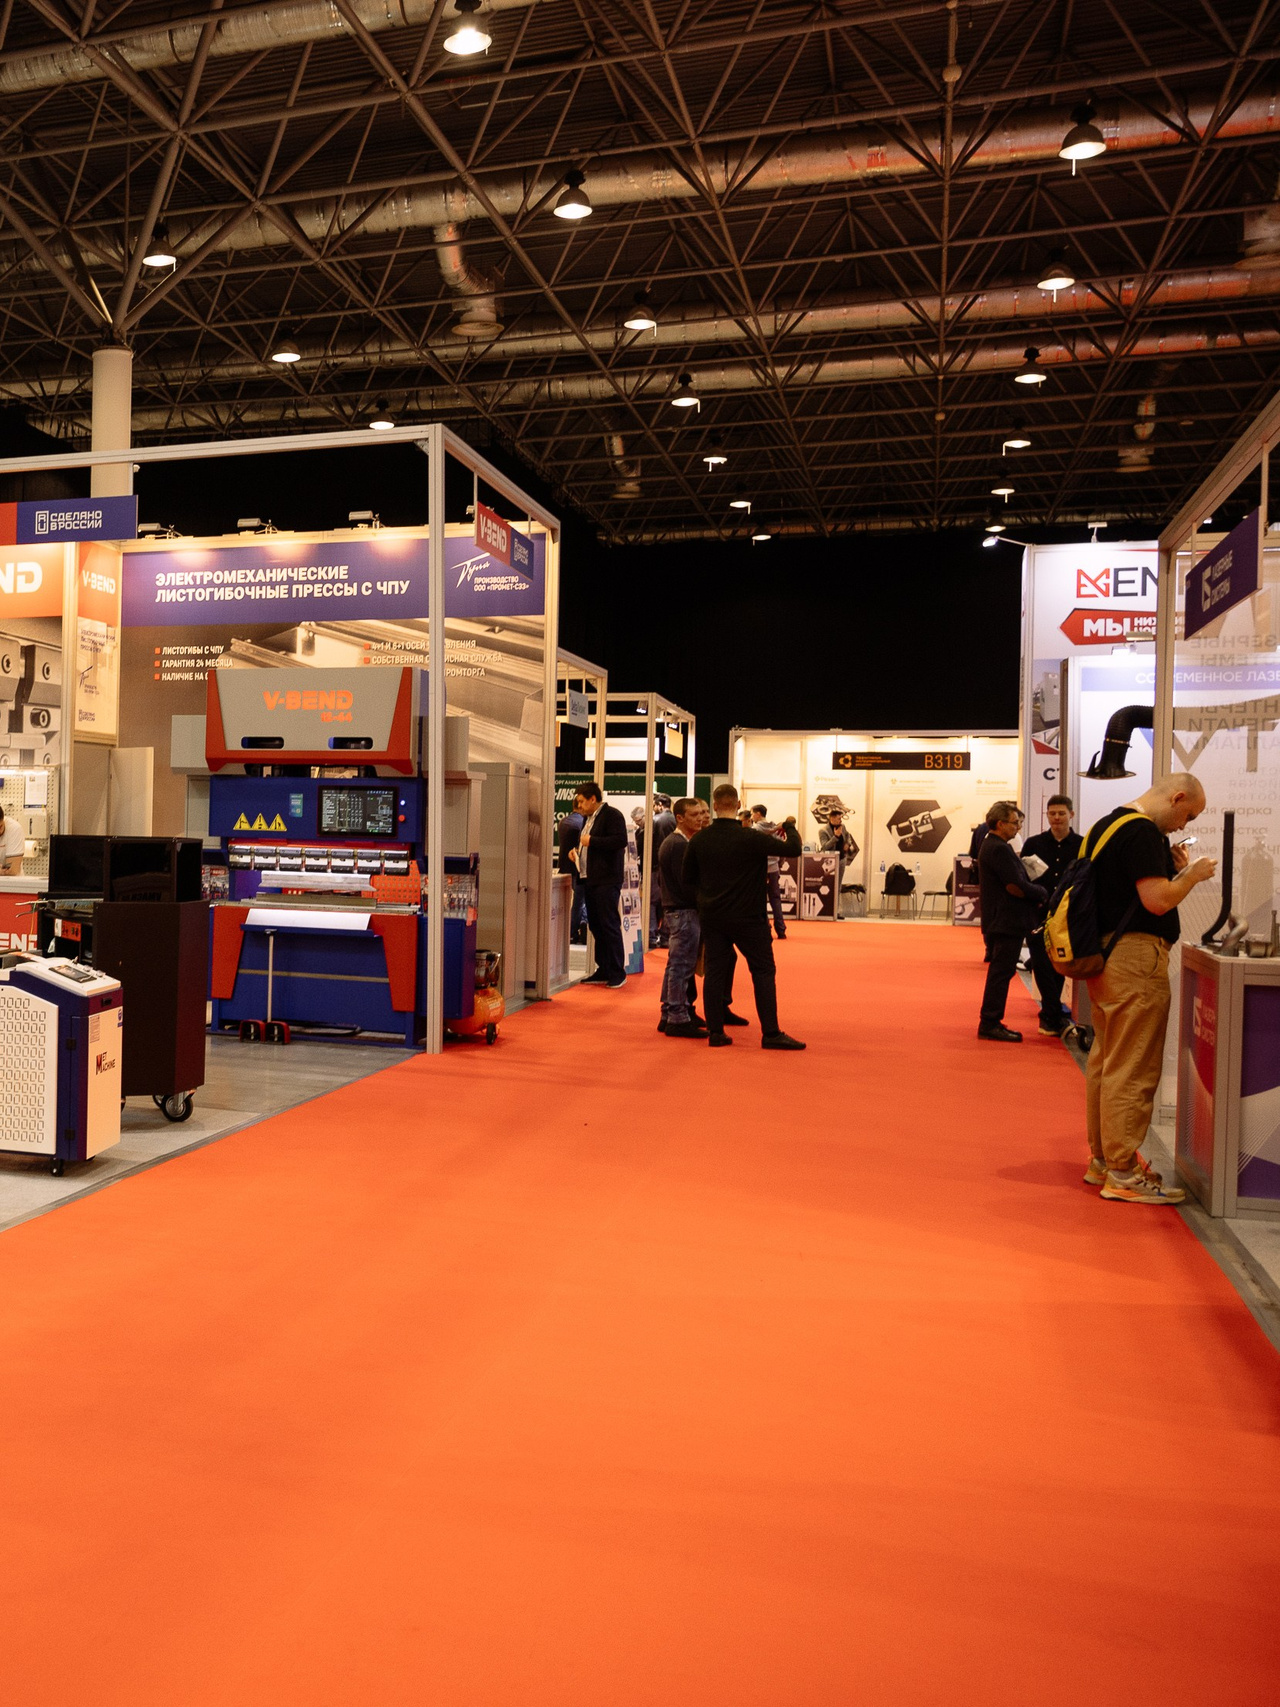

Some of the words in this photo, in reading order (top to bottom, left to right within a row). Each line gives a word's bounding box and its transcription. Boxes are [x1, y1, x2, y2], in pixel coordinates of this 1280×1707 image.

[50, 510, 102, 522] СДЕЛАНО
[479, 513, 507, 553] V-BEND
[82, 569, 116, 595] V-BEND
[155, 565, 349, 587] ЭЛЕКТРОМЕХАНИЧЕСКИЕ
[474, 575, 519, 584] ПРОИЗВОДСТВО
[155, 585, 289, 603] ЛИСТОГИБОЧНЫЕ
[292, 582, 358, 599] ПРЕССЫ
[361, 581, 372, 596] С
[376, 580, 410, 596] ЧПУ
[1083, 617, 1131, 638] МЫ
[162, 646, 204, 655] ЛИСТОГИБЫ
[204, 645, 210, 654] С
[210, 645, 224, 654] ЧПУ
[406, 640, 426, 650] ОСЕЙ
[162, 659, 195, 668] ГАРАНТИЯ
[196, 658, 205, 668] 24
[205, 658, 234, 668] МЕСЯЦА
[372, 655, 425, 665] СОБСТВЕННАЯ
[162, 672, 192, 681] НАЛИЧИЕ
[193, 672, 204, 681] НА
[1135, 671, 1243, 684] СОЕМЕННОЕ
[1246, 669, 1280, 682] ЛАЗЕ
[262, 690, 353, 710] V-BEND
[924, 754, 963, 769] B319
